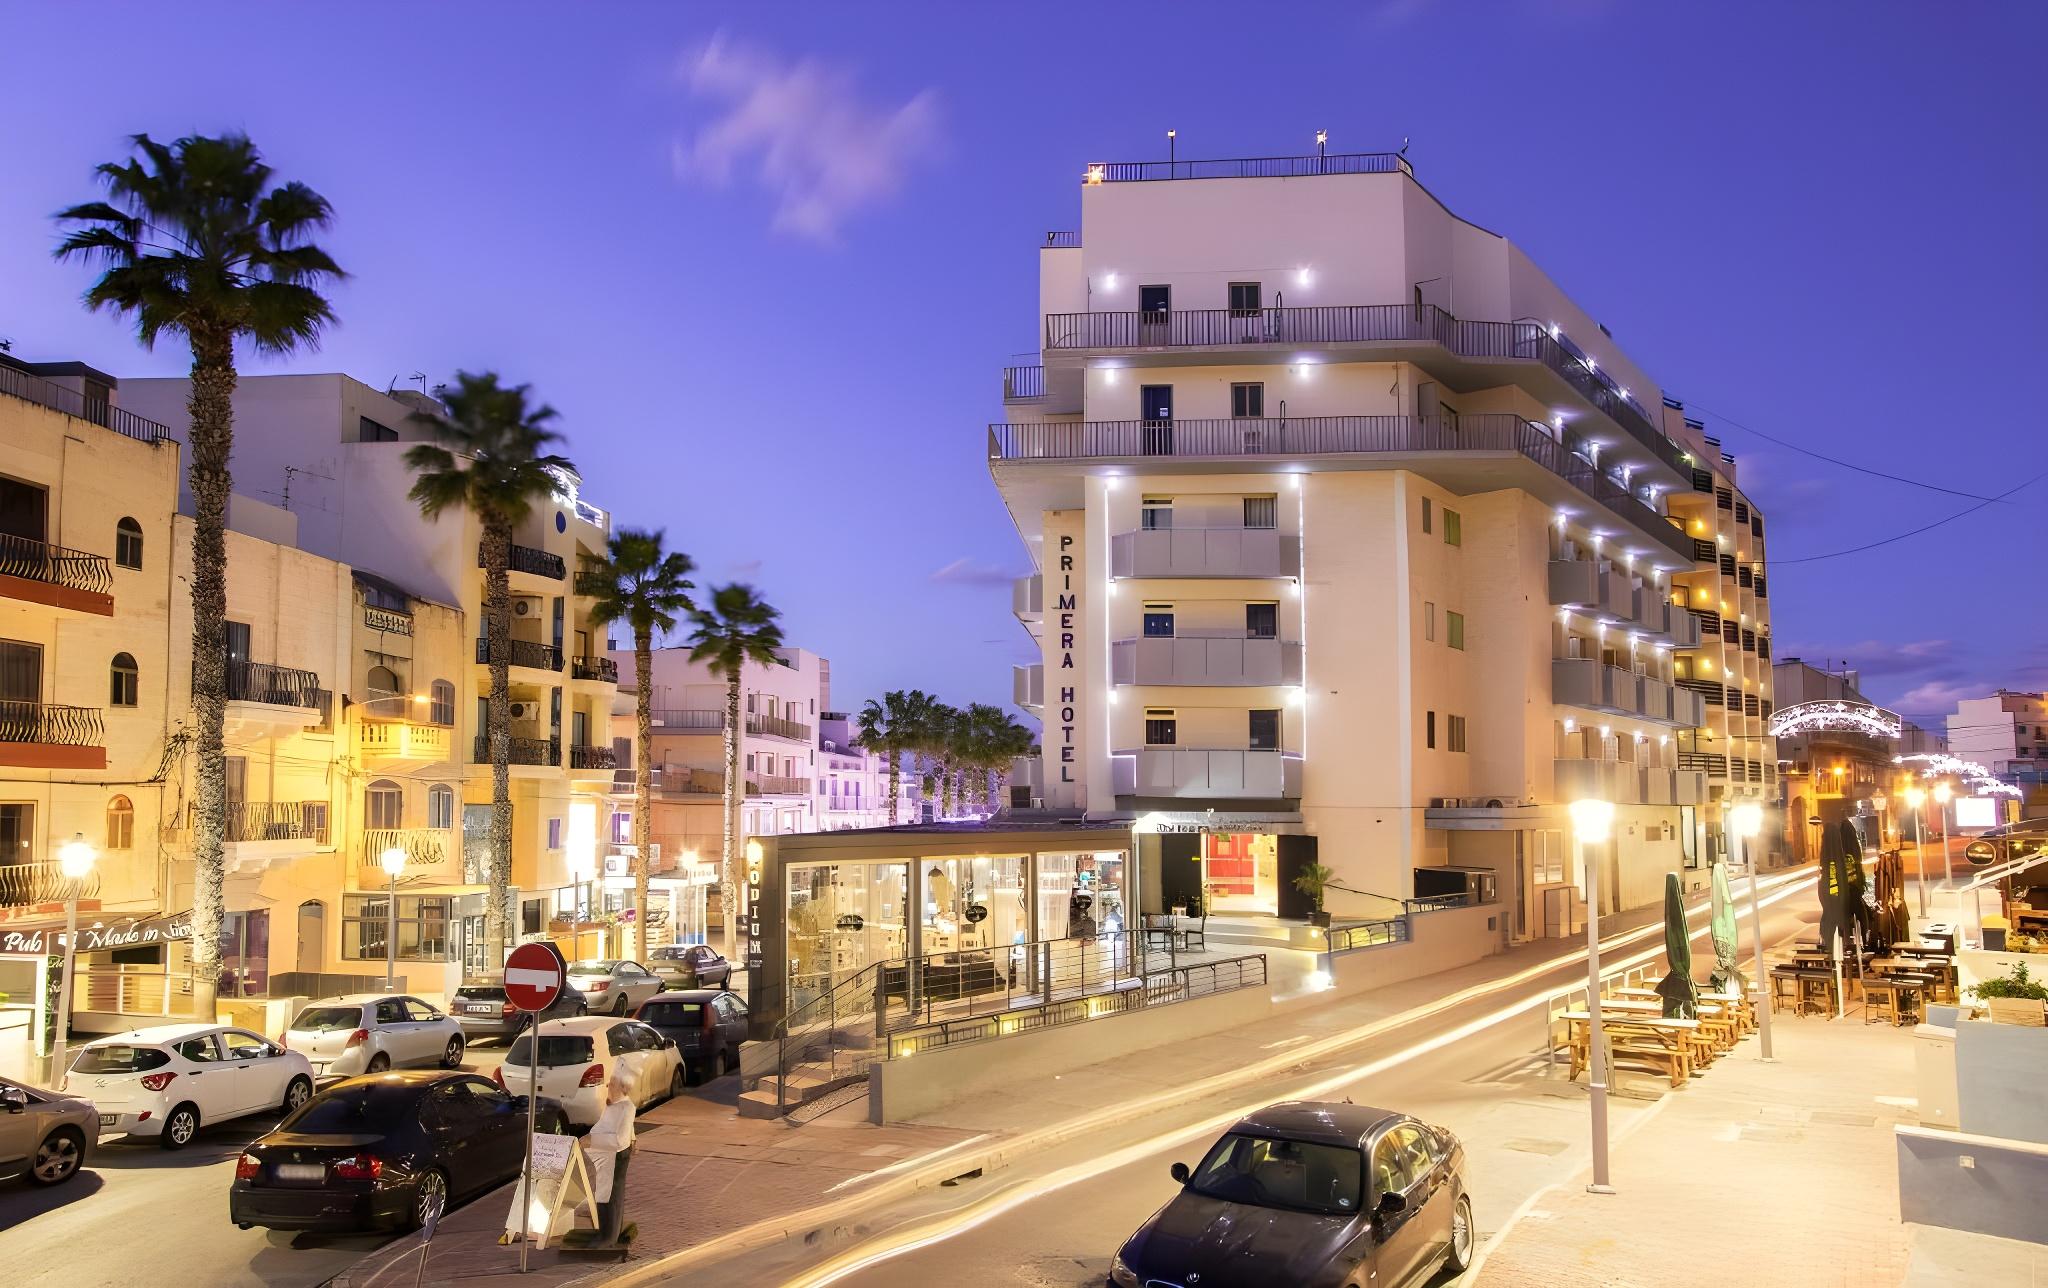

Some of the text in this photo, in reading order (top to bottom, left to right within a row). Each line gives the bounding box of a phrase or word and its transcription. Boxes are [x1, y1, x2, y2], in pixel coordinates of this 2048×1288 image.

[1059, 535, 1076, 783] PRIMERA HOTEL
[87, 921, 139, 950] Made
[749, 856, 762, 954] ODIUM
[3, 930, 43, 953] Pub
